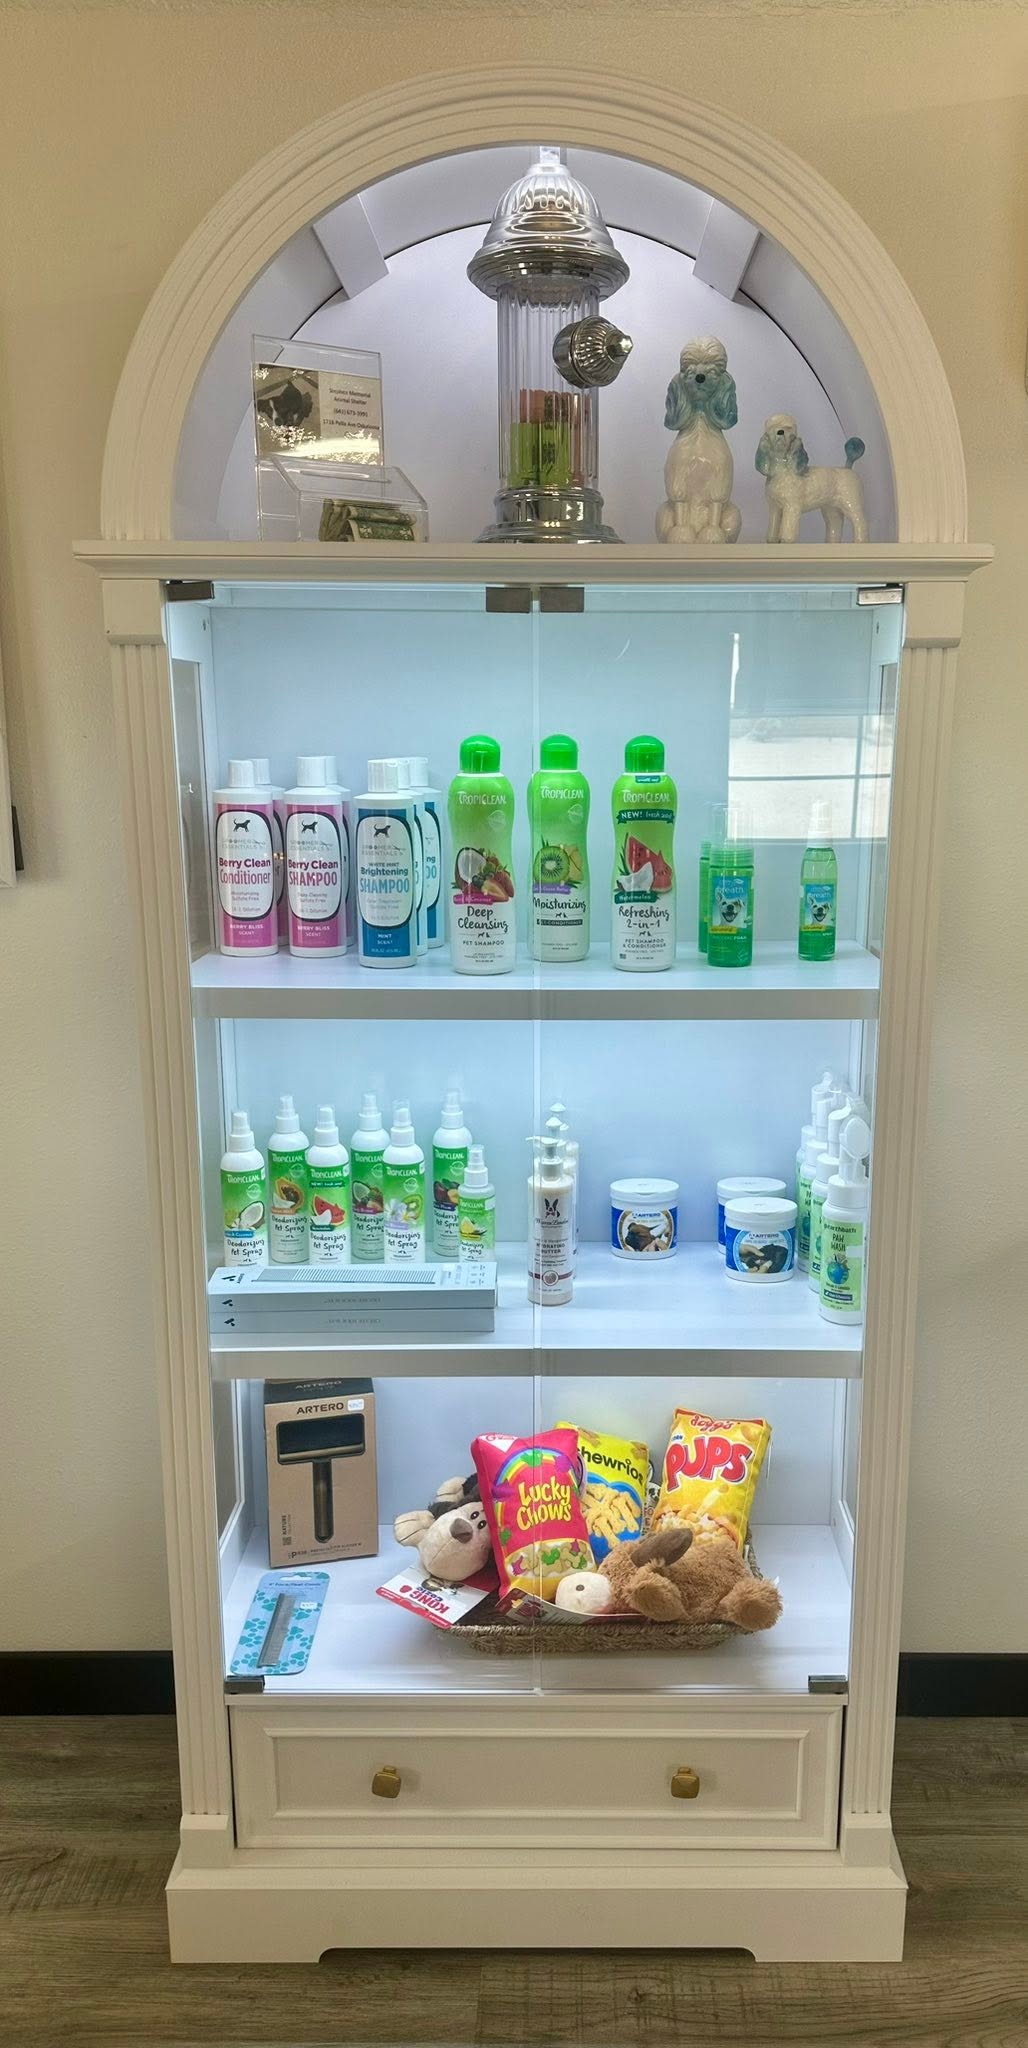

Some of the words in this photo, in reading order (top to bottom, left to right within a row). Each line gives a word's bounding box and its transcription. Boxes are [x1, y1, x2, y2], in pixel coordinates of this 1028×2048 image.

[219, 857, 242, 869] Berry
[244, 858, 271, 868] Clean
[288, 859, 309, 871] Berry
[311, 860, 338, 869] Clean
[220, 868, 271, 885] Conditioner
[289, 870, 337, 887] SHAMPOO
[361, 867, 409, 878] Brightening
[360, 878, 410, 894] SHAMPOO
[533, 897, 587, 913] Moisturizing
[467, 905, 494, 920] Deep
[618, 905, 671, 922] Refreshing
[457, 916, 509, 933] Cleansing
[627, 918, 660, 929] 2-in-1
[272, 1215, 307, 1225] Deodorizing
[285, 1224, 305, 1233] Spray
[310, 1232, 347, 1243] Deodorizing
[386, 1230, 421, 1241] Deodorizing
[832, 1234, 844, 1242] PAW
[227, 1239, 265, 1248] Deodorizing
[323, 1242, 344, 1252] Spray
[397, 1240, 418, 1250] Spray
[830, 1242, 847, 1252] WASH
[242, 1248, 263, 1257] Spray
[296, 1402, 344, 1415] ARTERO
[578, 1446, 645, 1487] hewrios
[666, 1435, 753, 1493] PUPS
[518, 1475, 571, 1507] Lucky
[409, 1590, 450, 1614] KONG
